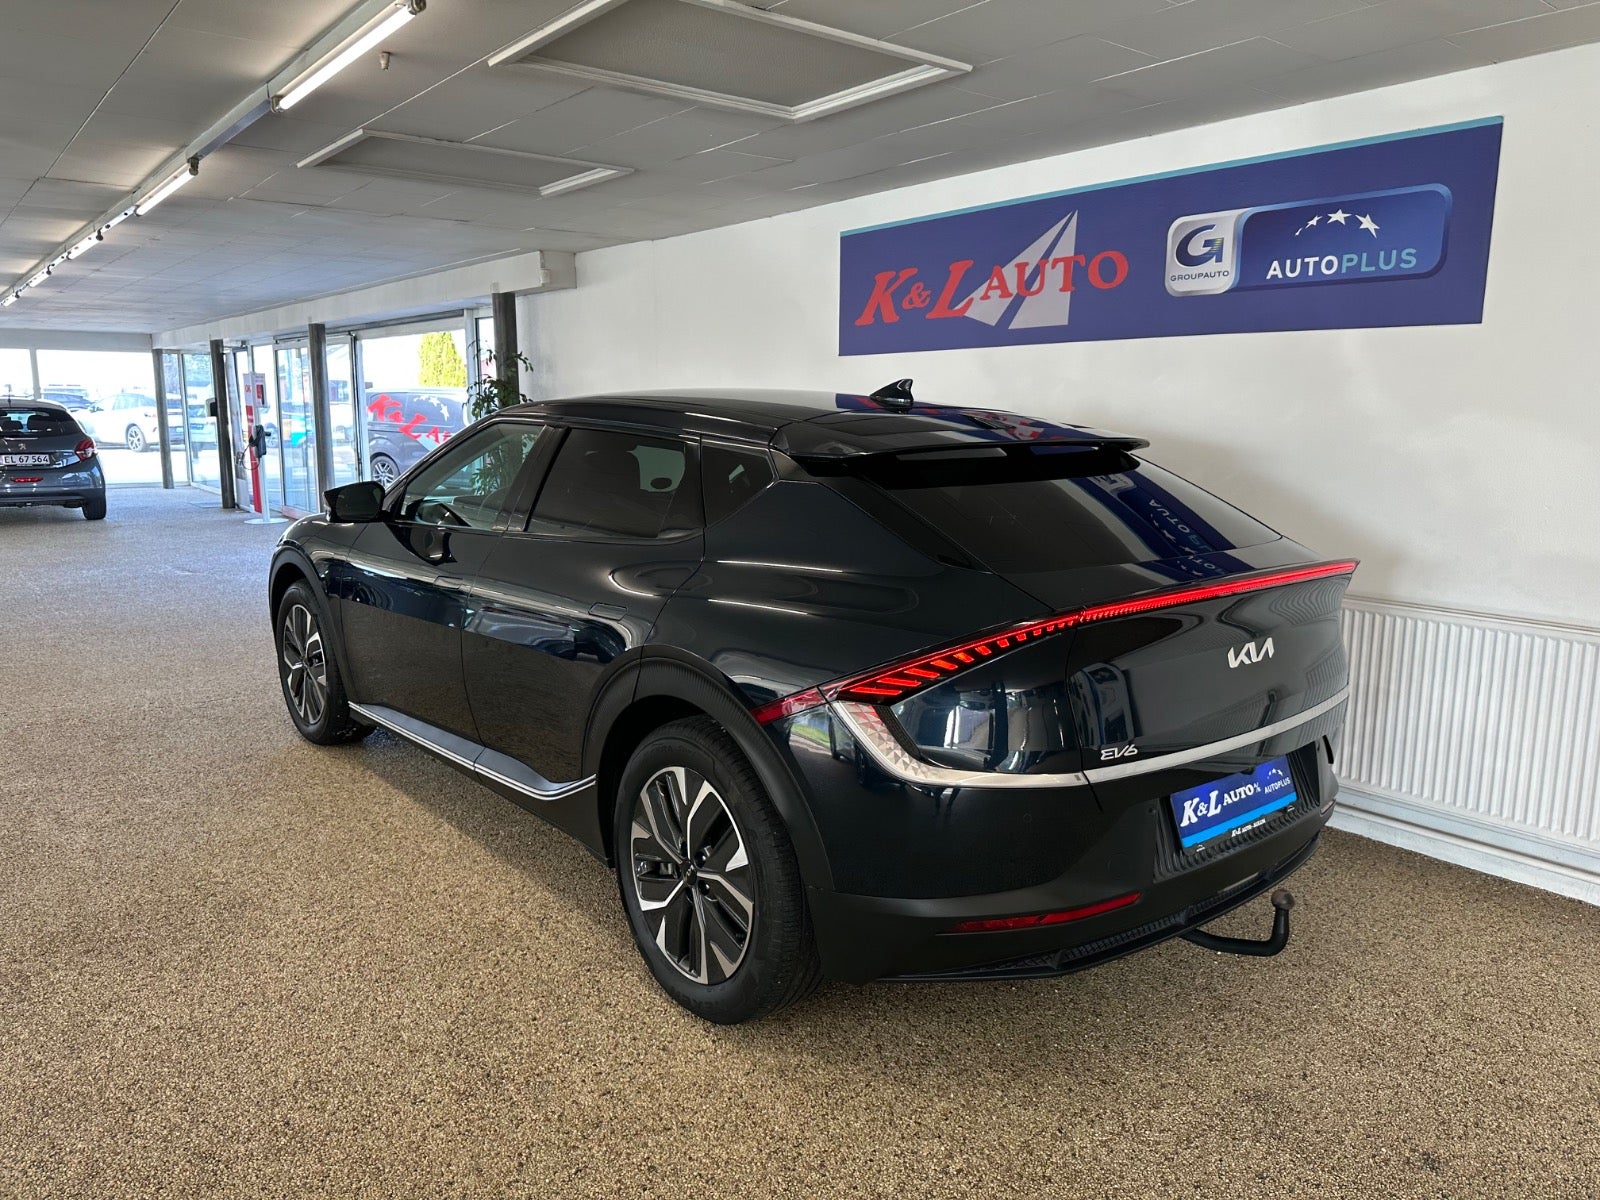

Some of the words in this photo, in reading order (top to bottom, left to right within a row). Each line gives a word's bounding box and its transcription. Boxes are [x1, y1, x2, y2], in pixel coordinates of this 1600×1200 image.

[1265, 247, 1417, 280] AUTOPLUS
[1170, 270, 1230, 282] GROUPAUTO
[854, 259, 974, 327] K&L
[979, 250, 1129, 301] AUTO
[4, 455, 16, 464] EL
[18, 455, 30, 463] 67
[31, 455, 49, 463] 564
[1100, 743, 1139, 760] EV6
[1264, 776, 1290, 794] AUTOPLUS
[1180, 790, 1222, 827] K&L
[1222, 783, 1254, 806] AUTO
